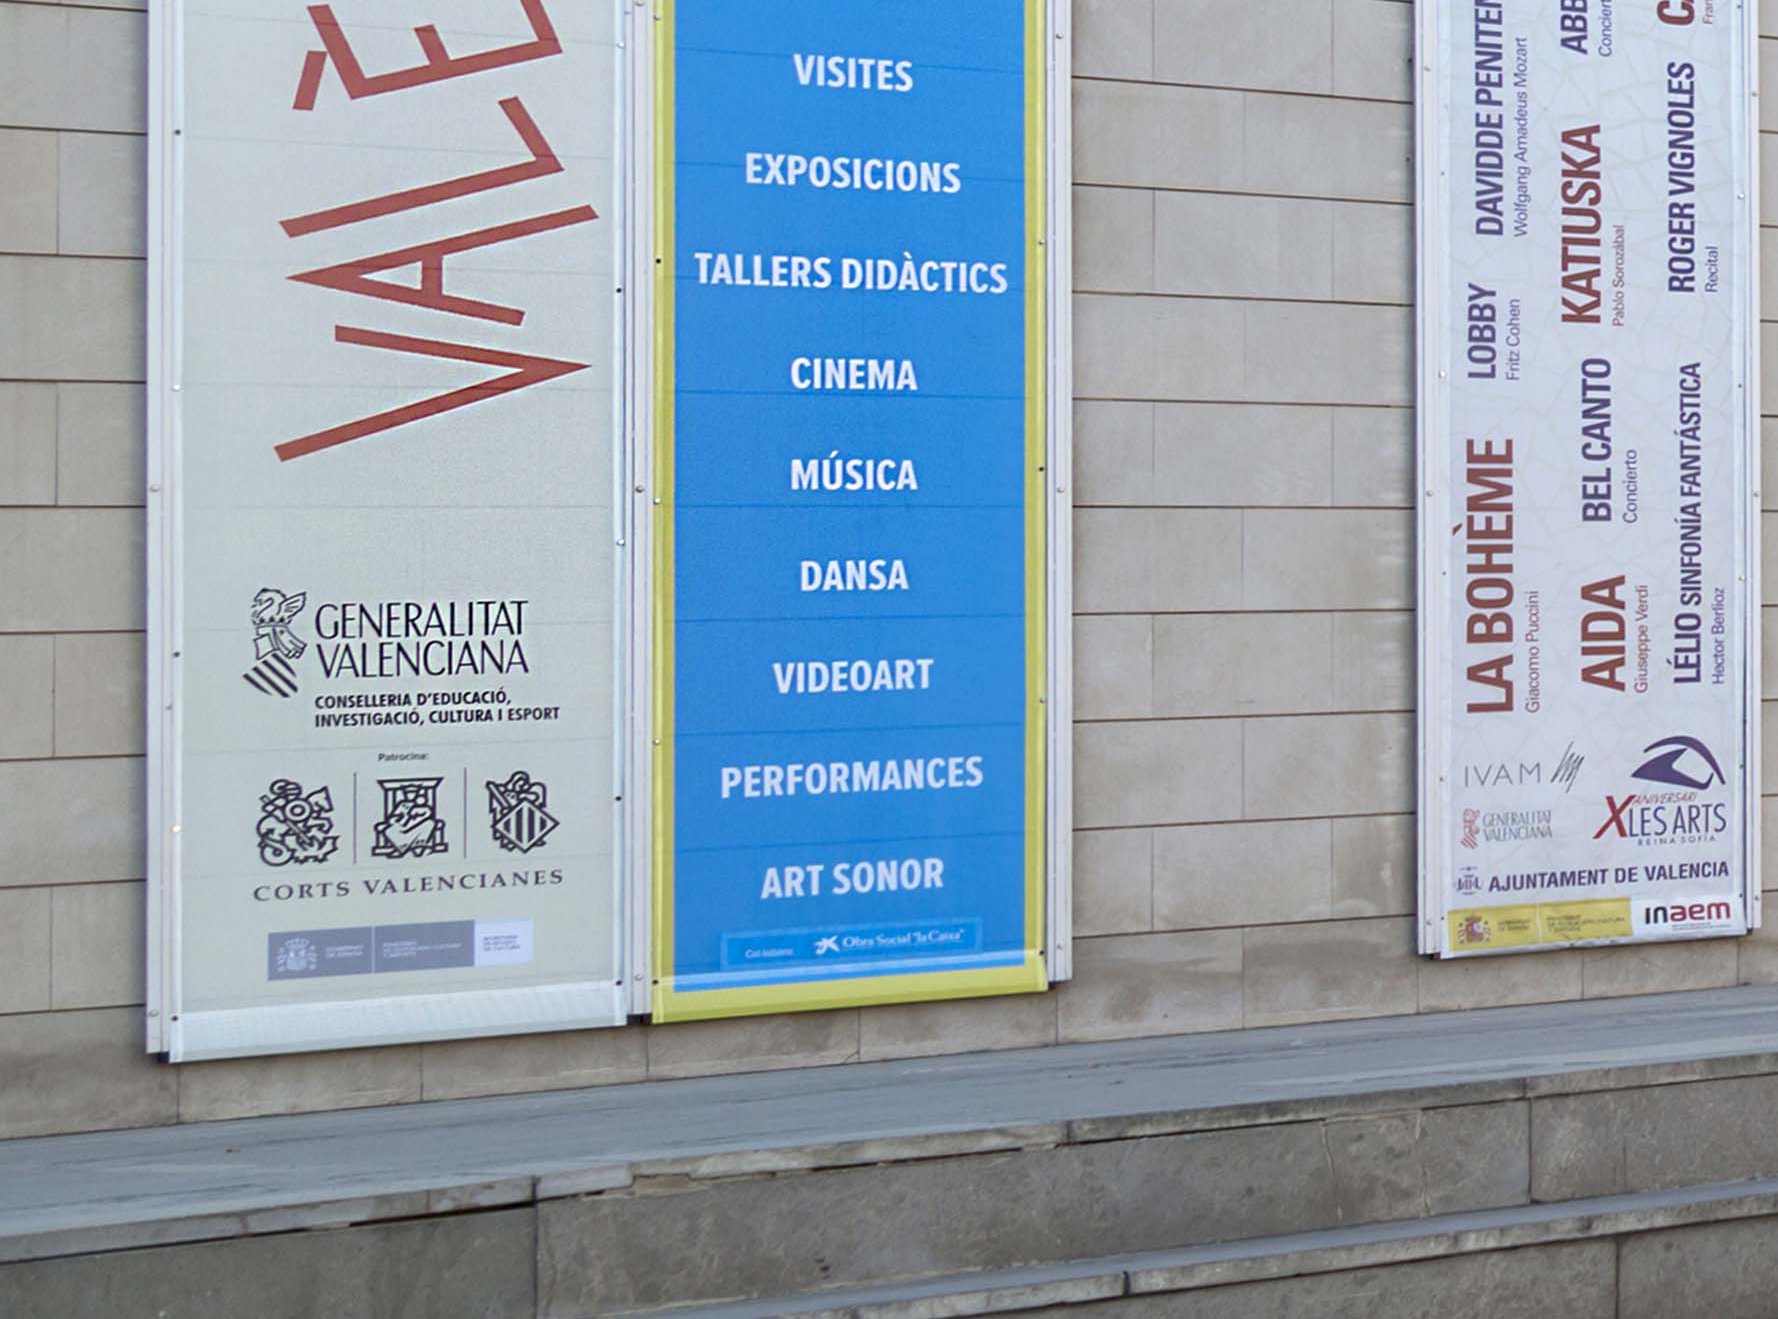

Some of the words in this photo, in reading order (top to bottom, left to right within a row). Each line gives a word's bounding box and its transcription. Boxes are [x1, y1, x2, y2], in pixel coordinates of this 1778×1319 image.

[793, 54, 913, 92] VISITES
[1514, 37, 1528, 87] Mozart
[1668, 61, 1695, 199] VIGNOLES
[746, 153, 961, 193] EXPOSICIONS
[1475, 111, 1504, 236] DAVIDDE
[1514, 163, 1531, 237] Wolfgang
[1561, 125, 1601, 324] KATIUSKA
[1668, 201, 1695, 293] ROGER
[694, 253, 831, 289] TALLERS
[842, 252, 1008, 294] DIDÀCTICS
[1706, 246, 1719, 293] Recital
[1468, 282, 1496, 380] LOBBY
[1506, 298, 1520, 349] Cohen
[791, 357, 918, 391] CINEMA
[1582, 358, 1611, 461] CANTO
[1674, 362, 1701, 497] FANTÁSTICA
[791, 451, 918, 490] MÚSICA
[1582, 467, 1611, 522] BEL
[1623, 449, 1638, 524] Concierto
[1452, 439, 1513, 644] BOHÈME
[1674, 502, 1701, 606] SINFONÍA
[800, 559, 909, 592] DANSA
[315, 600, 528, 640] GENERALITAT
[1525, 590, 1540, 642] Puccini
[1581, 575, 1626, 692] AIDA
[317, 639, 529, 679] VALENCIANA
[1666, 612, 1701, 684] LÉLIO
[774, 658, 933, 694] VIDEOART
[1466, 654, 1513, 714] LA
[1525, 645, 1540, 714] Giacomo
[315, 692, 412, 710] CONSELLERIA
[315, 708, 425, 727] INVESTIGACIÓ,
[429, 709, 493, 724] CULTURA
[508, 706, 560, 721] ESPORT
[721, 756, 983, 799] PERFORMANCES
[1465, 762, 1541, 788] IVAM
[1628, 806, 1667, 838] LES
[1672, 803, 1727, 834] ARTS
[253, 880, 350, 902] CORTS
[362, 869, 564, 896] VALENCIANES
[761, 866, 824, 899] ART
[833, 858, 944, 895] SONOR
[1488, 868, 1607, 893] AJUNTAMENT
[1615, 868, 1638, 883] DE
[1643, 861, 1728, 881] VALENCIA
[1645, 901, 1731, 924] inaem
